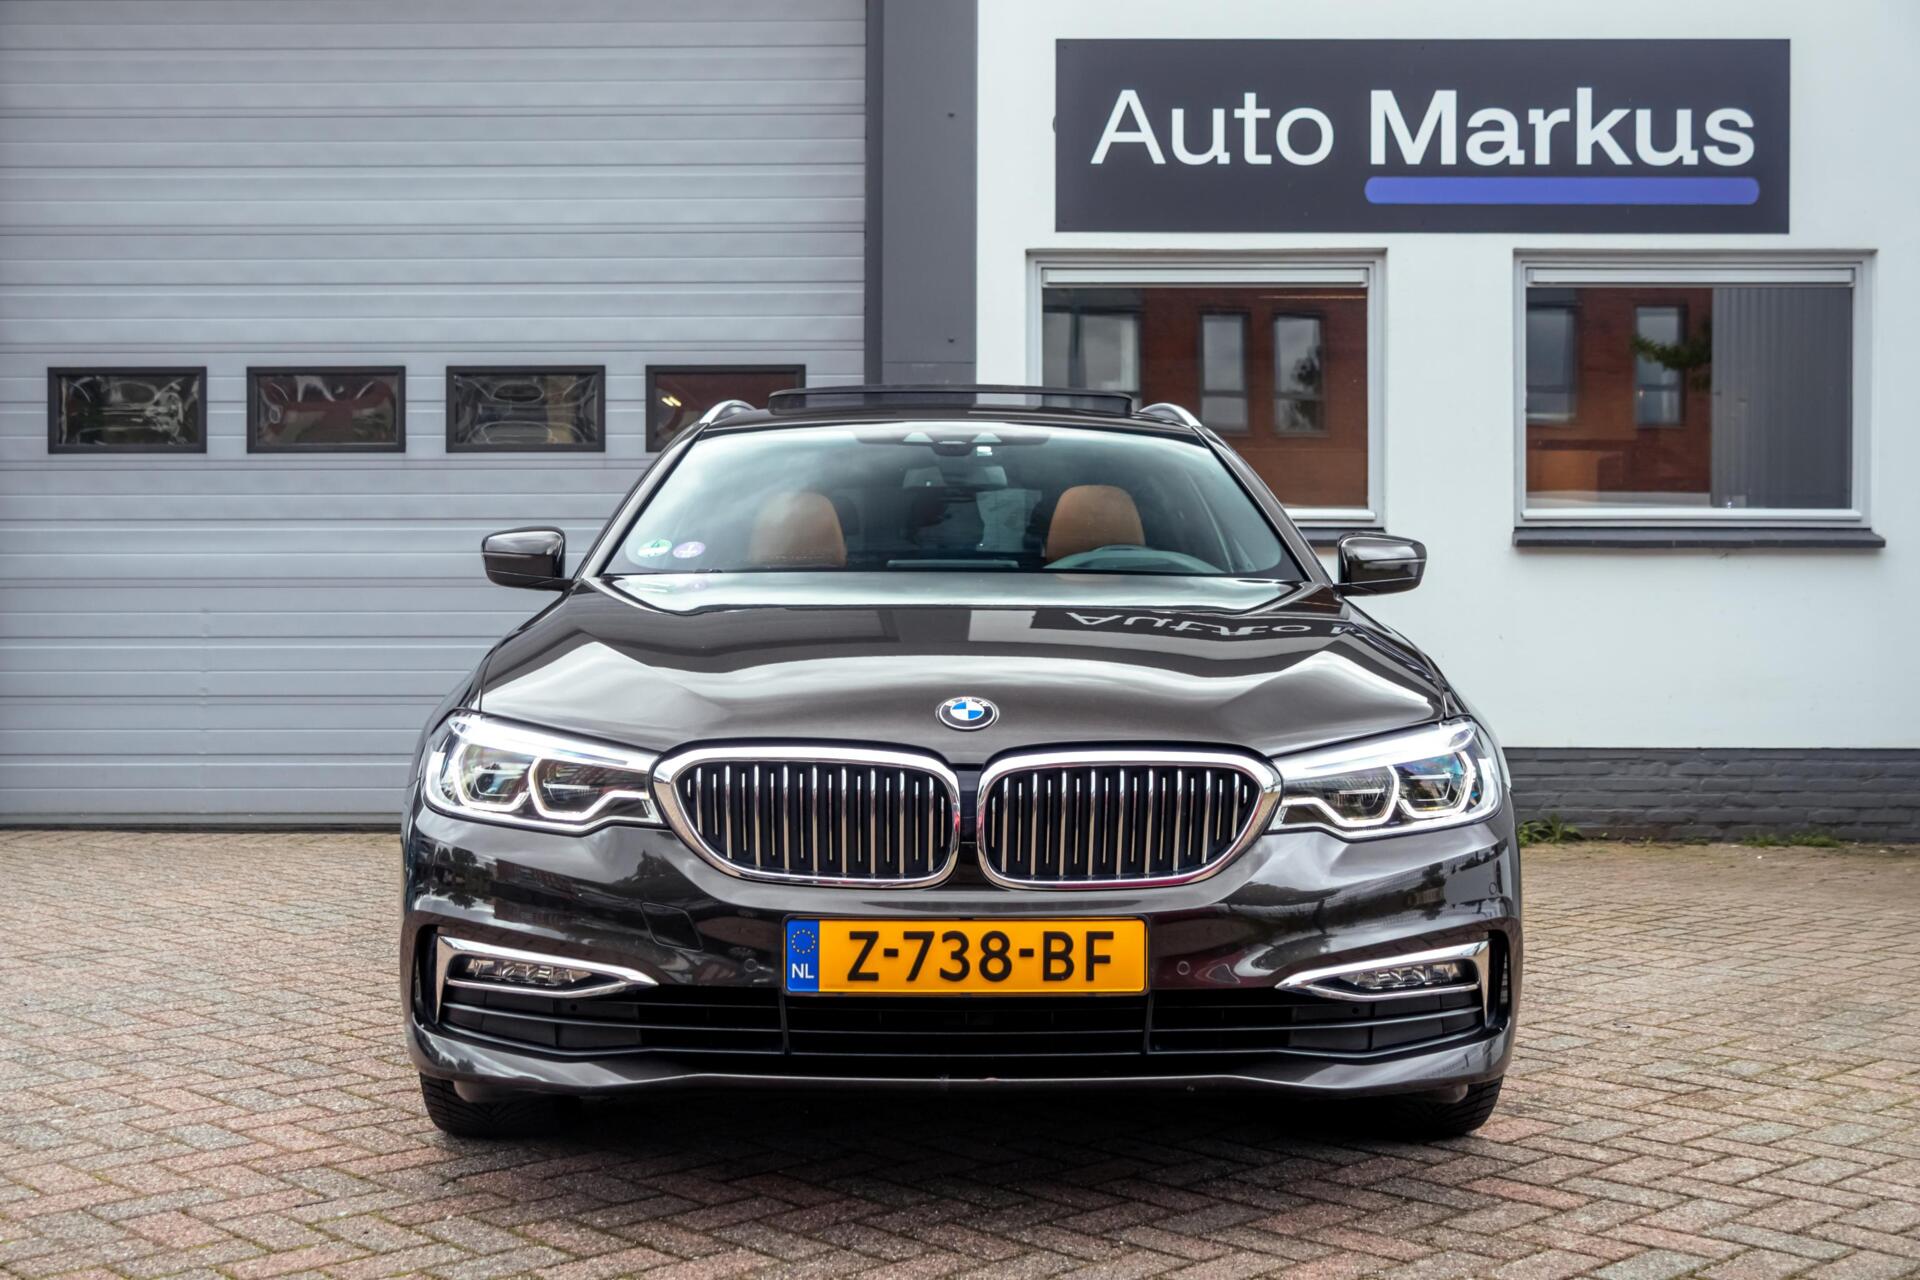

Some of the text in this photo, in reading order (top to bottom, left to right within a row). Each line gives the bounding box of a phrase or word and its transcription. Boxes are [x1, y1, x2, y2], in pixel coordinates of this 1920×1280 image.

[1090, 87, 1755, 167] Auto Markus
[791, 963, 815, 979] NL
[846, 930, 1114, 983] Z-738-BF
